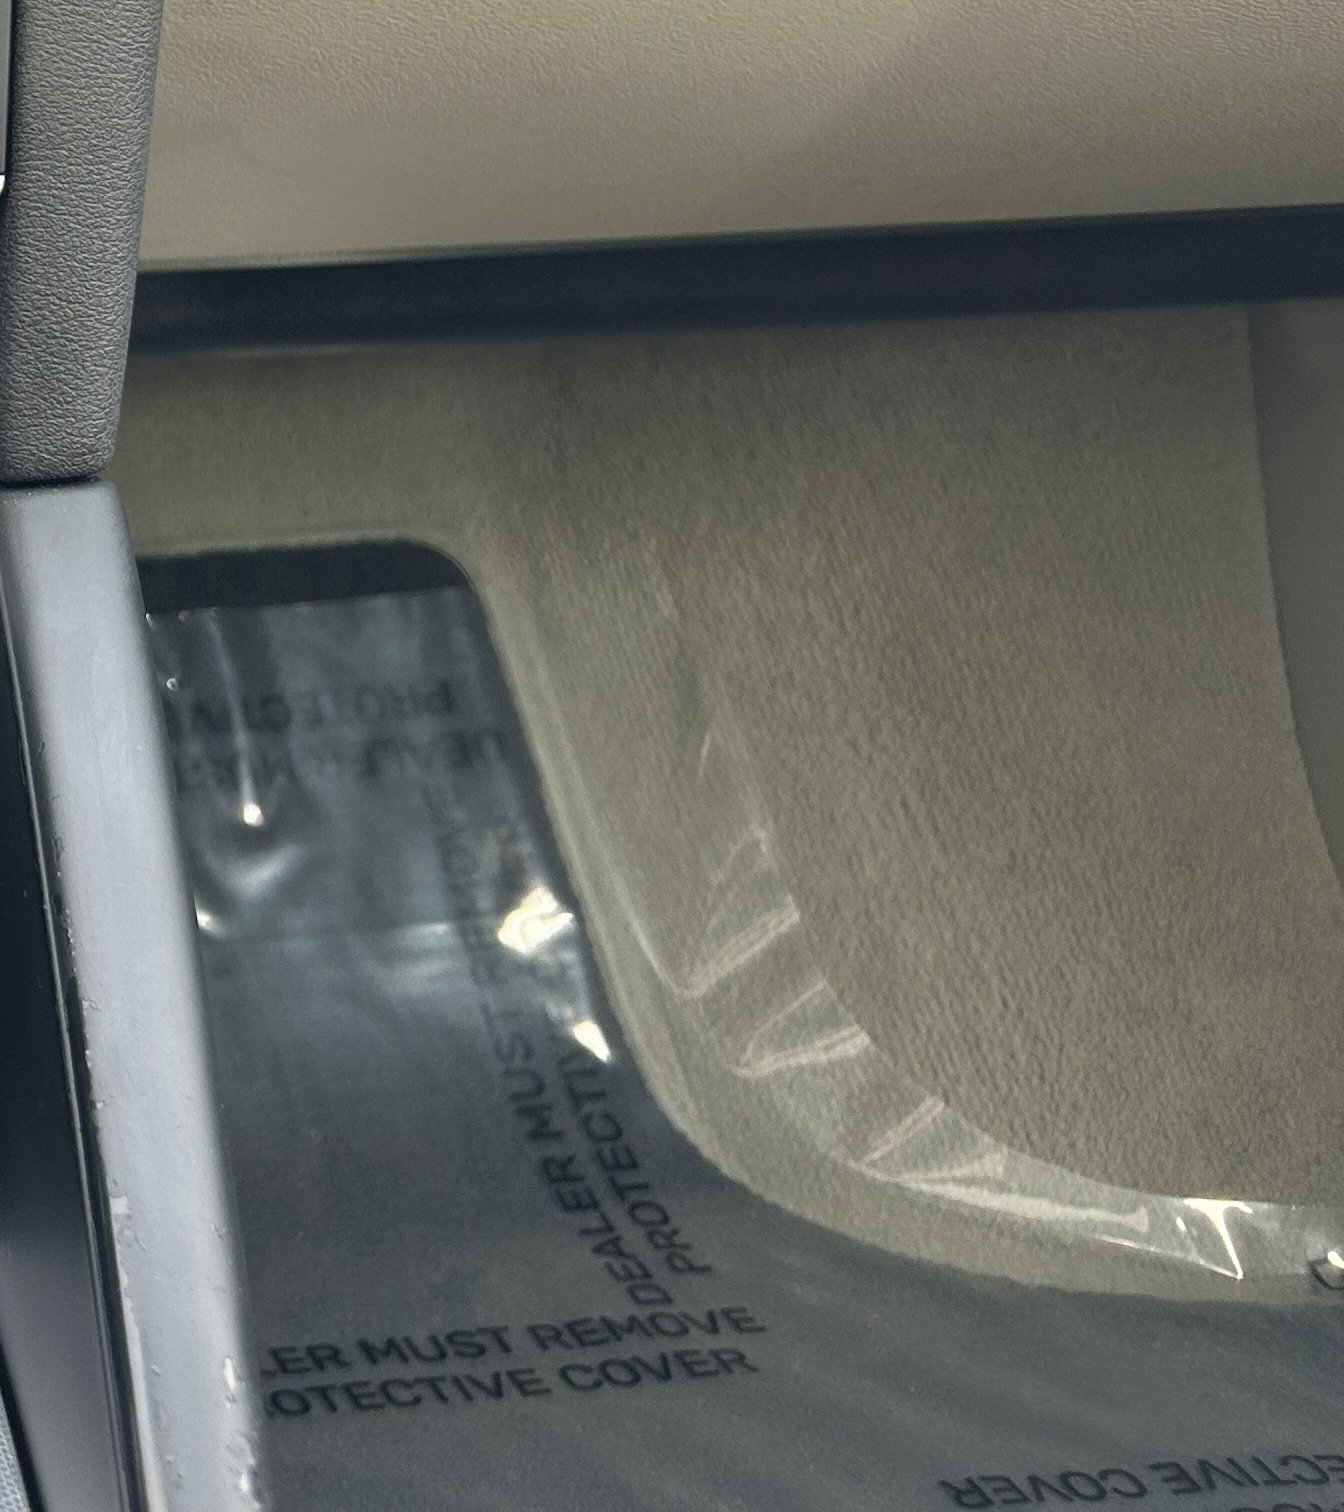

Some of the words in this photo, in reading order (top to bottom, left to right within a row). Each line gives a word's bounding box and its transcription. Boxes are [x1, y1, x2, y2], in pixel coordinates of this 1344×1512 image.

[554, 1040, 713, 1276] PROTECTIV
[542, 1155, 673, 1307] DEALER
[357, 1326, 513, 1366] MUST
[526, 1306, 766, 1352] REMOVE
[266, 1367, 552, 1419] OTECTIVE
[558, 1347, 760, 1392] COVER
[938, 1467, 1148, 1510] COVER
